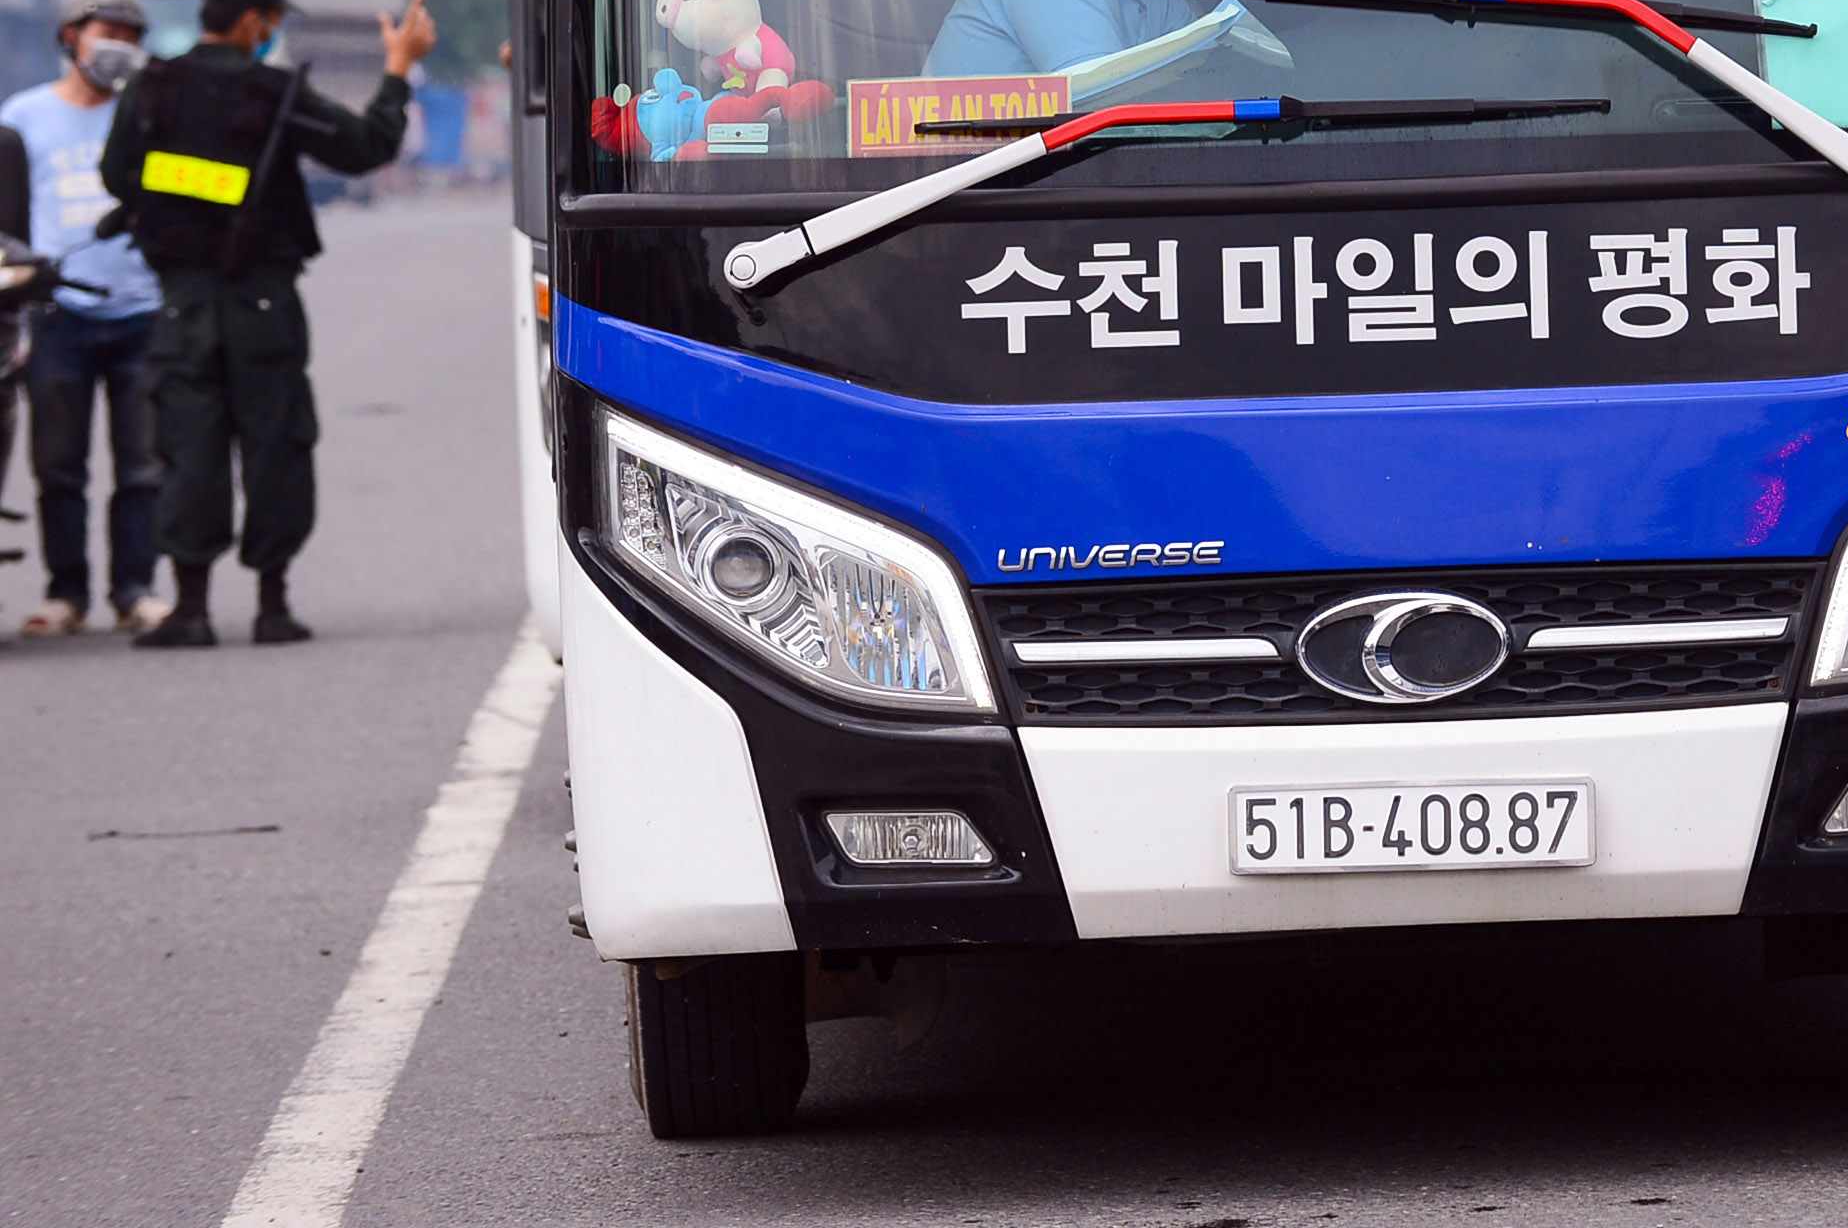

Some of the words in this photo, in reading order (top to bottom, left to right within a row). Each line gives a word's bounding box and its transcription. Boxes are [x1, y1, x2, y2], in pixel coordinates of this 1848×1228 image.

[861, 84, 900, 145] LÁI
[907, 96, 941, 144] XE
[950, 94, 983, 139] AN
[961, 239, 1181, 354] 수천
[1221, 230, 1551, 345] 마일의
[1588, 226, 1812, 339] 평화
[998, 540, 1225, 572] UNIVERSE
[1245, 790, 1579, 861] 51B-408.87
